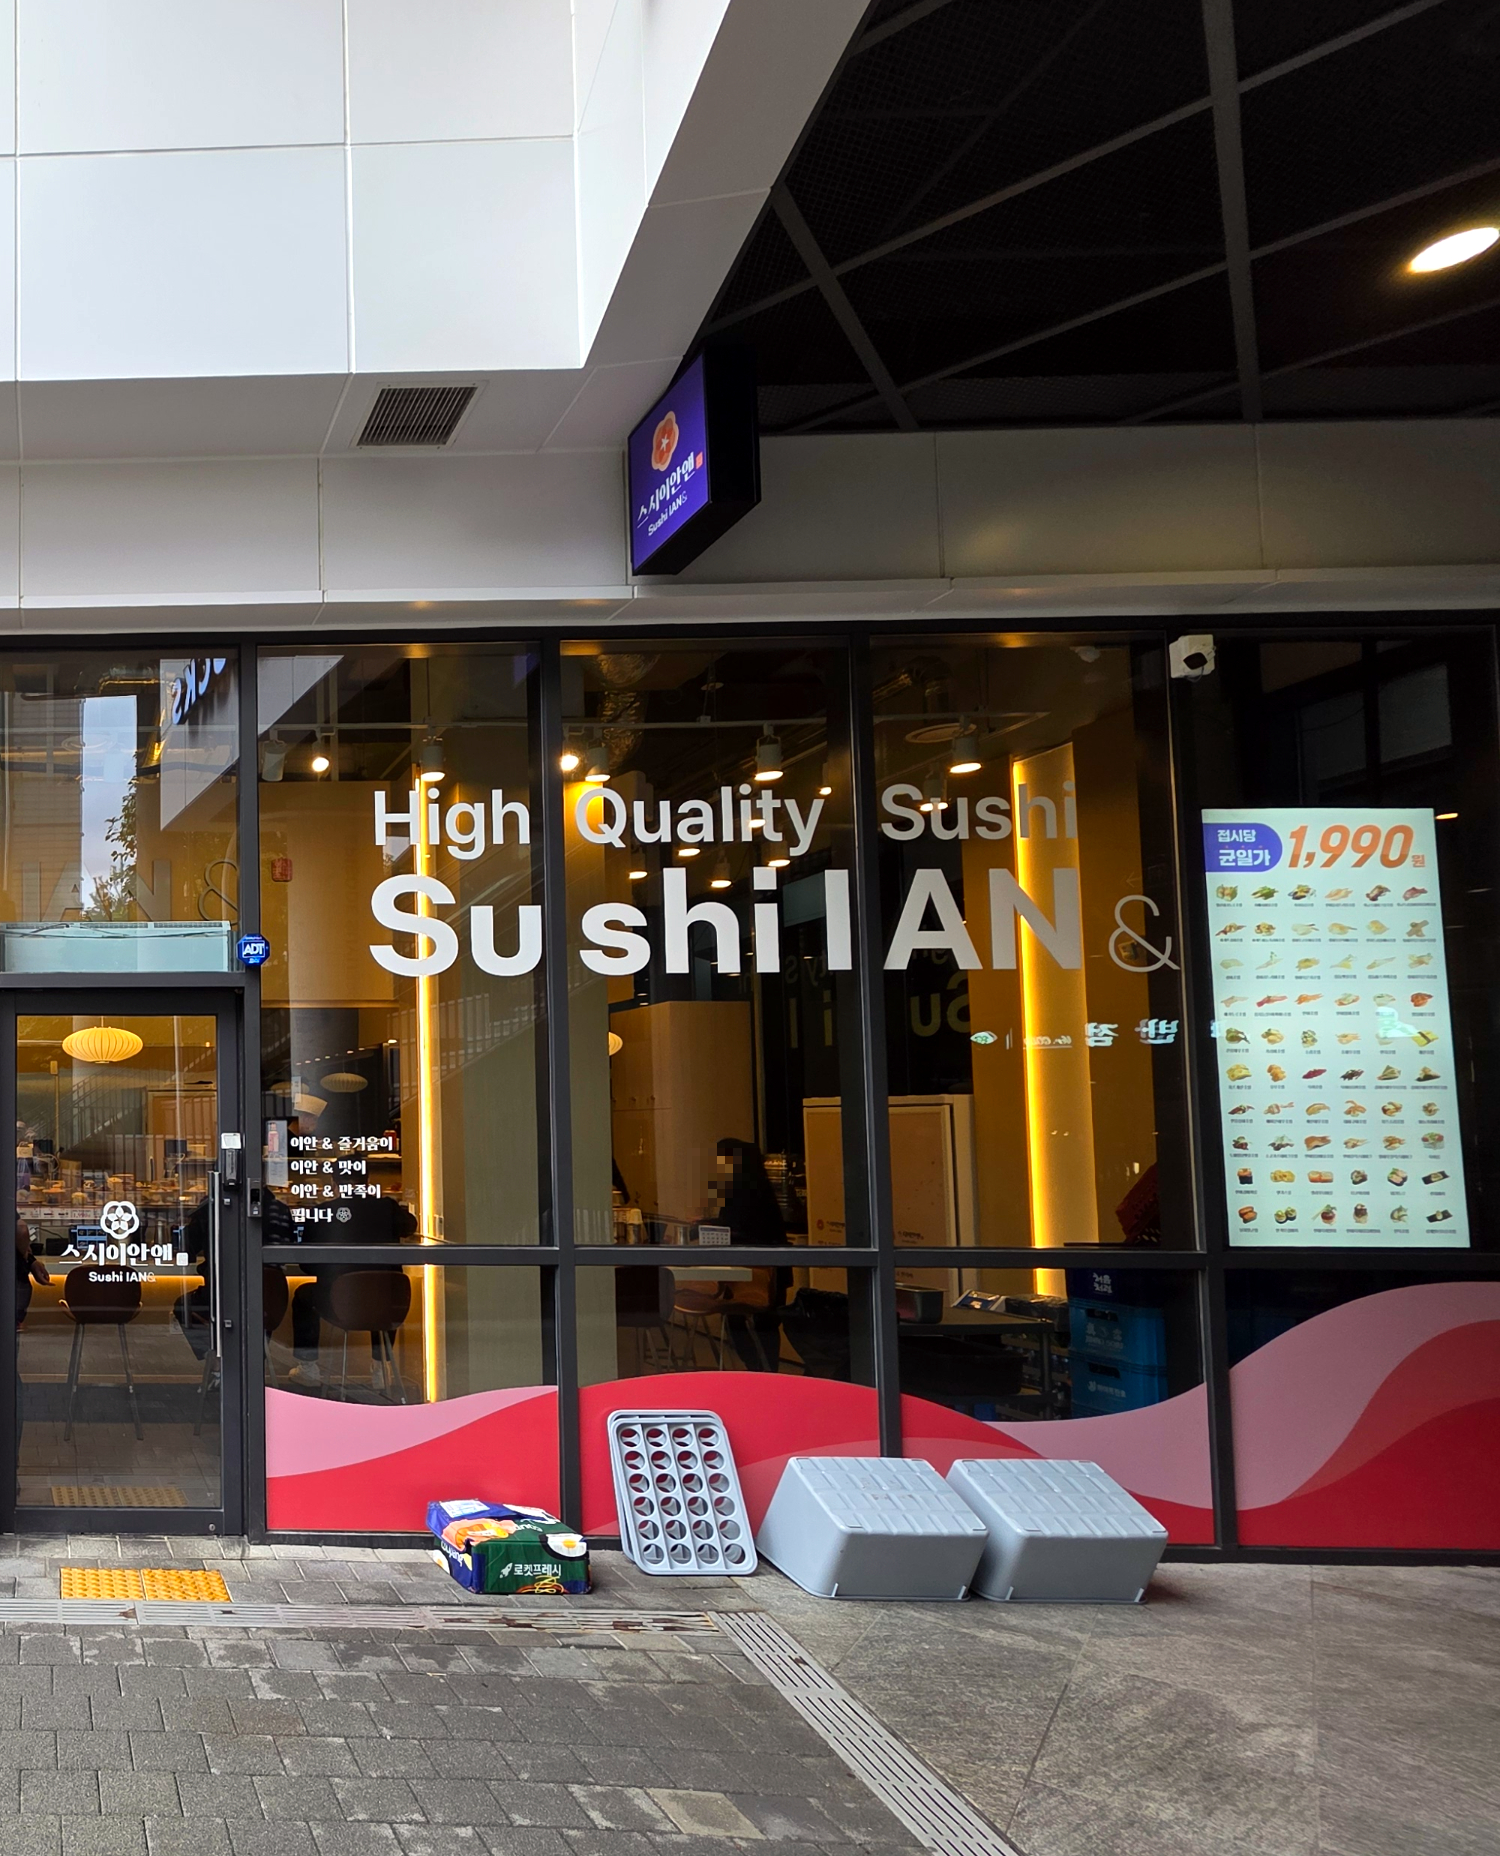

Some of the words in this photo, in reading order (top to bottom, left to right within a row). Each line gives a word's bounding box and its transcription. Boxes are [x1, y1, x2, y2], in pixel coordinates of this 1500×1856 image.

[637, 451, 696, 529] 스시이안앤
[648, 508, 668, 536] Sushi
[372, 788, 531, 860] High
[574, 784, 825, 856] Quality
[880, 780, 1078, 843] Sushi
[1217, 828, 1256, 843] 접시당
[1218, 849, 1271, 867] 균일가
[243, 942, 265, 955] ADT
[290, 1136, 318, 1151] 이안
[322, 1138, 333, 1150] &
[338, 1136, 393, 1151] 즐거움이
[290, 1160, 318, 1175] 이안
[322, 1161, 334, 1174] &
[338, 1160, 367, 1175] 맛이
[291, 1184, 318, 1199] 이안
[322, 1185, 334, 1198] &
[338, 1184, 381, 1199] 만족이
[58, 1242, 174, 1267] 스시이안앤
[88, 1271, 123, 1283] Sushi
[513, 1563, 562, 1577] 로켓프레시
